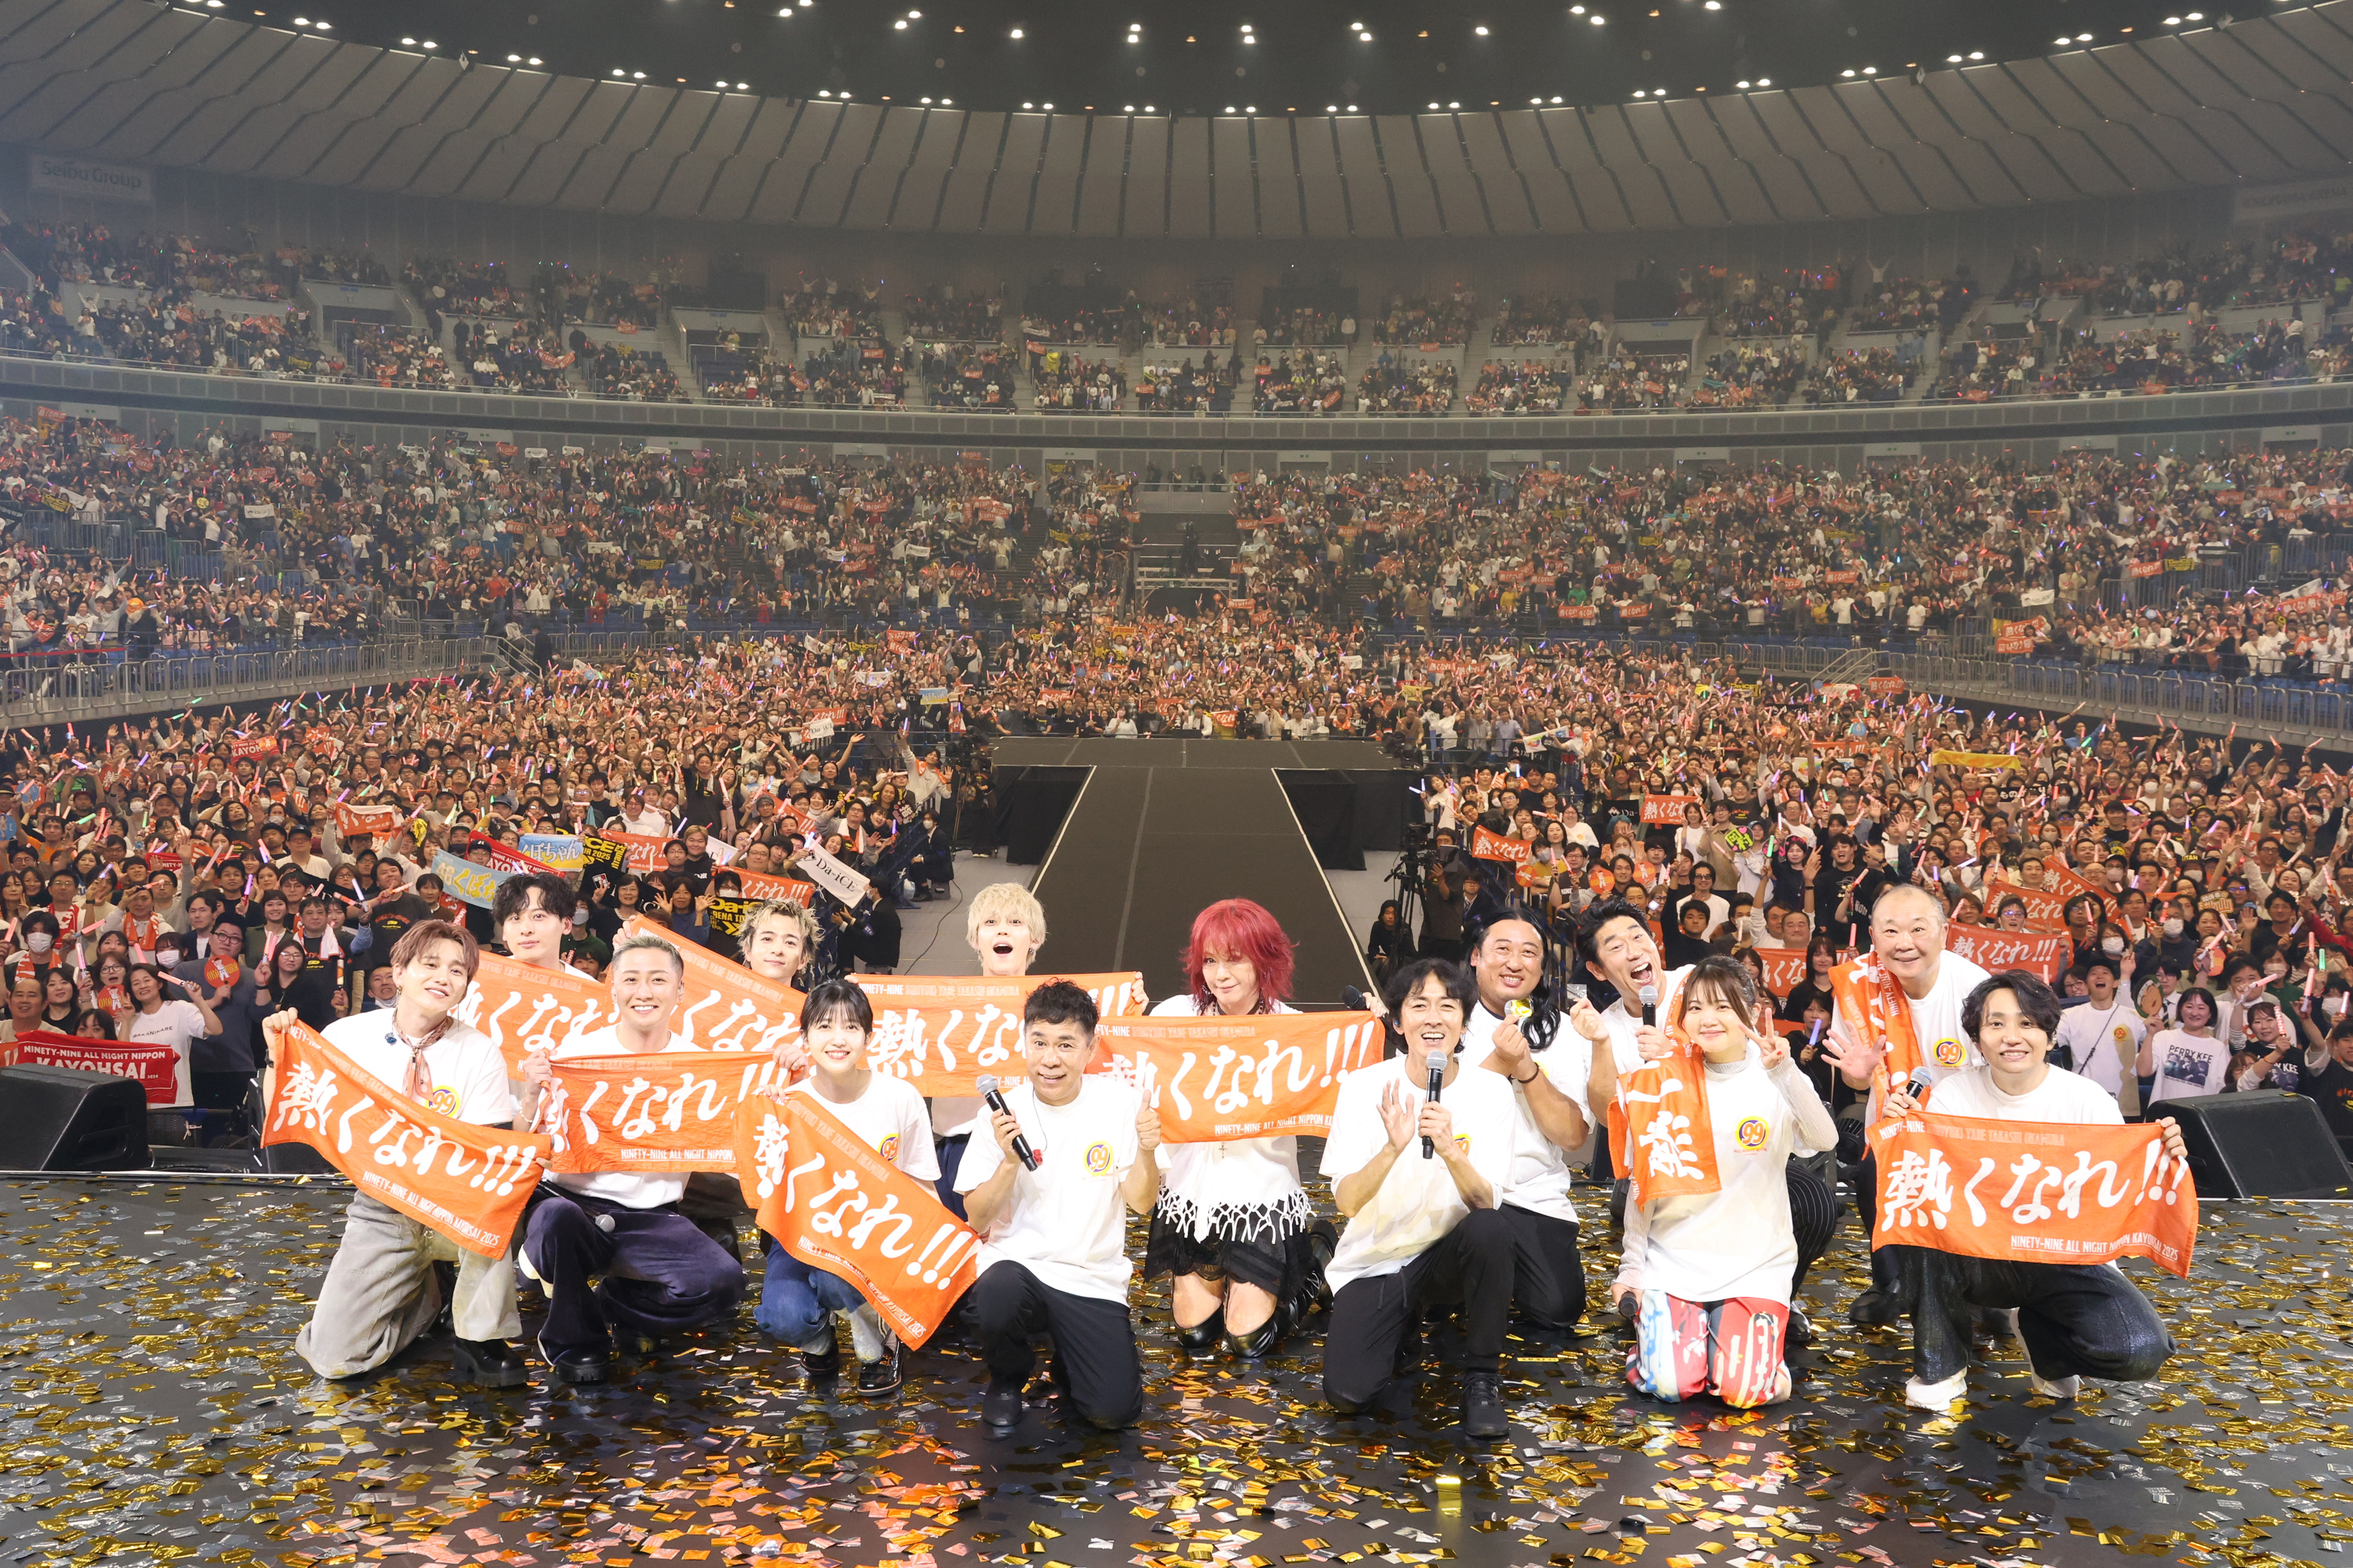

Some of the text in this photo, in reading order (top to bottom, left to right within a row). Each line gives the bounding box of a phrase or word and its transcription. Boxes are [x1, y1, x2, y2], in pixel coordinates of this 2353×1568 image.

[42, 160, 142, 189] Seibu Group
[1725, 827, 1754, 850] 岡村
[521, 840, 580, 863] くぼちゃん
[591, 849, 611, 861] 2025
[815, 857, 859, 892] Da-iCE
[1953, 935, 2058, 965] 熱くなれ!!!
[521, 970, 550, 985] TAKASHI
[549, 976, 582, 993] OKAMURA
[726, 970, 754, 991] TAKASHI
[752, 982, 785, 1005] OKAMURA
[938, 985, 956, 996] YABE
[957, 985, 986, 996] TAKASHI
[986, 985, 1020, 996] OKAMURA
[1167, 1026, 1187, 1038] YABE
[1188, 1025, 1219, 1038] TAKASHI
[1220, 1025, 1256, 1037] OKAMURA
[2115, 1028, 2126, 1038] 99
[24, 1045, 81, 1058] NINETY-NINE
[101, 1052, 129, 1060] NIGHT
[131, 1051, 165, 1060] NIPPON
[1939, 1043, 1960, 1063] 99
[1098, 1021, 1375, 1121] 熱くなれ!!!
[273, 1060, 536, 1196] 熱くなれ!!!
[1215, 1123, 1261, 1135] NINETY-NINE
[1298, 1114, 1324, 1125] NIPPON
[1742, 1121, 1765, 1145] 99
[1879, 1120, 1925, 1140] NINETY-NINE
[1965, 1128, 1987, 1141] YABE
[1988, 1129, 2022, 1144] TAKASHI
[2025, 1131, 2066, 1146] OKAMURA
[620, 1149, 732, 1160] NINETY-NINE ALL NIGHT NIPPON
[816, 1120, 836, 1140] YABE
[831, 1132, 862, 1160] TAKASHI
[857, 1152, 890, 1183] OKAMURA
[1089, 1146, 1110, 1171] 99
[1881, 1138, 2188, 1231] 熱くなれ!!!
[363, 1171, 501, 1247] NINETY-NINE ALL NIGHT NIPPON KAYOHSAI 2025
[754, 1114, 983, 1291] 熱くなれ!!!
[2011, 1232, 2179, 1261] NINETY-NINE ALL NIGHT NIPPON KAYOHSAI 2025
[868, 1281, 890, 1303] NIPPON
[884, 1299, 915, 1326] KAYOHSAI
[909, 1320, 927, 1338] 2025
